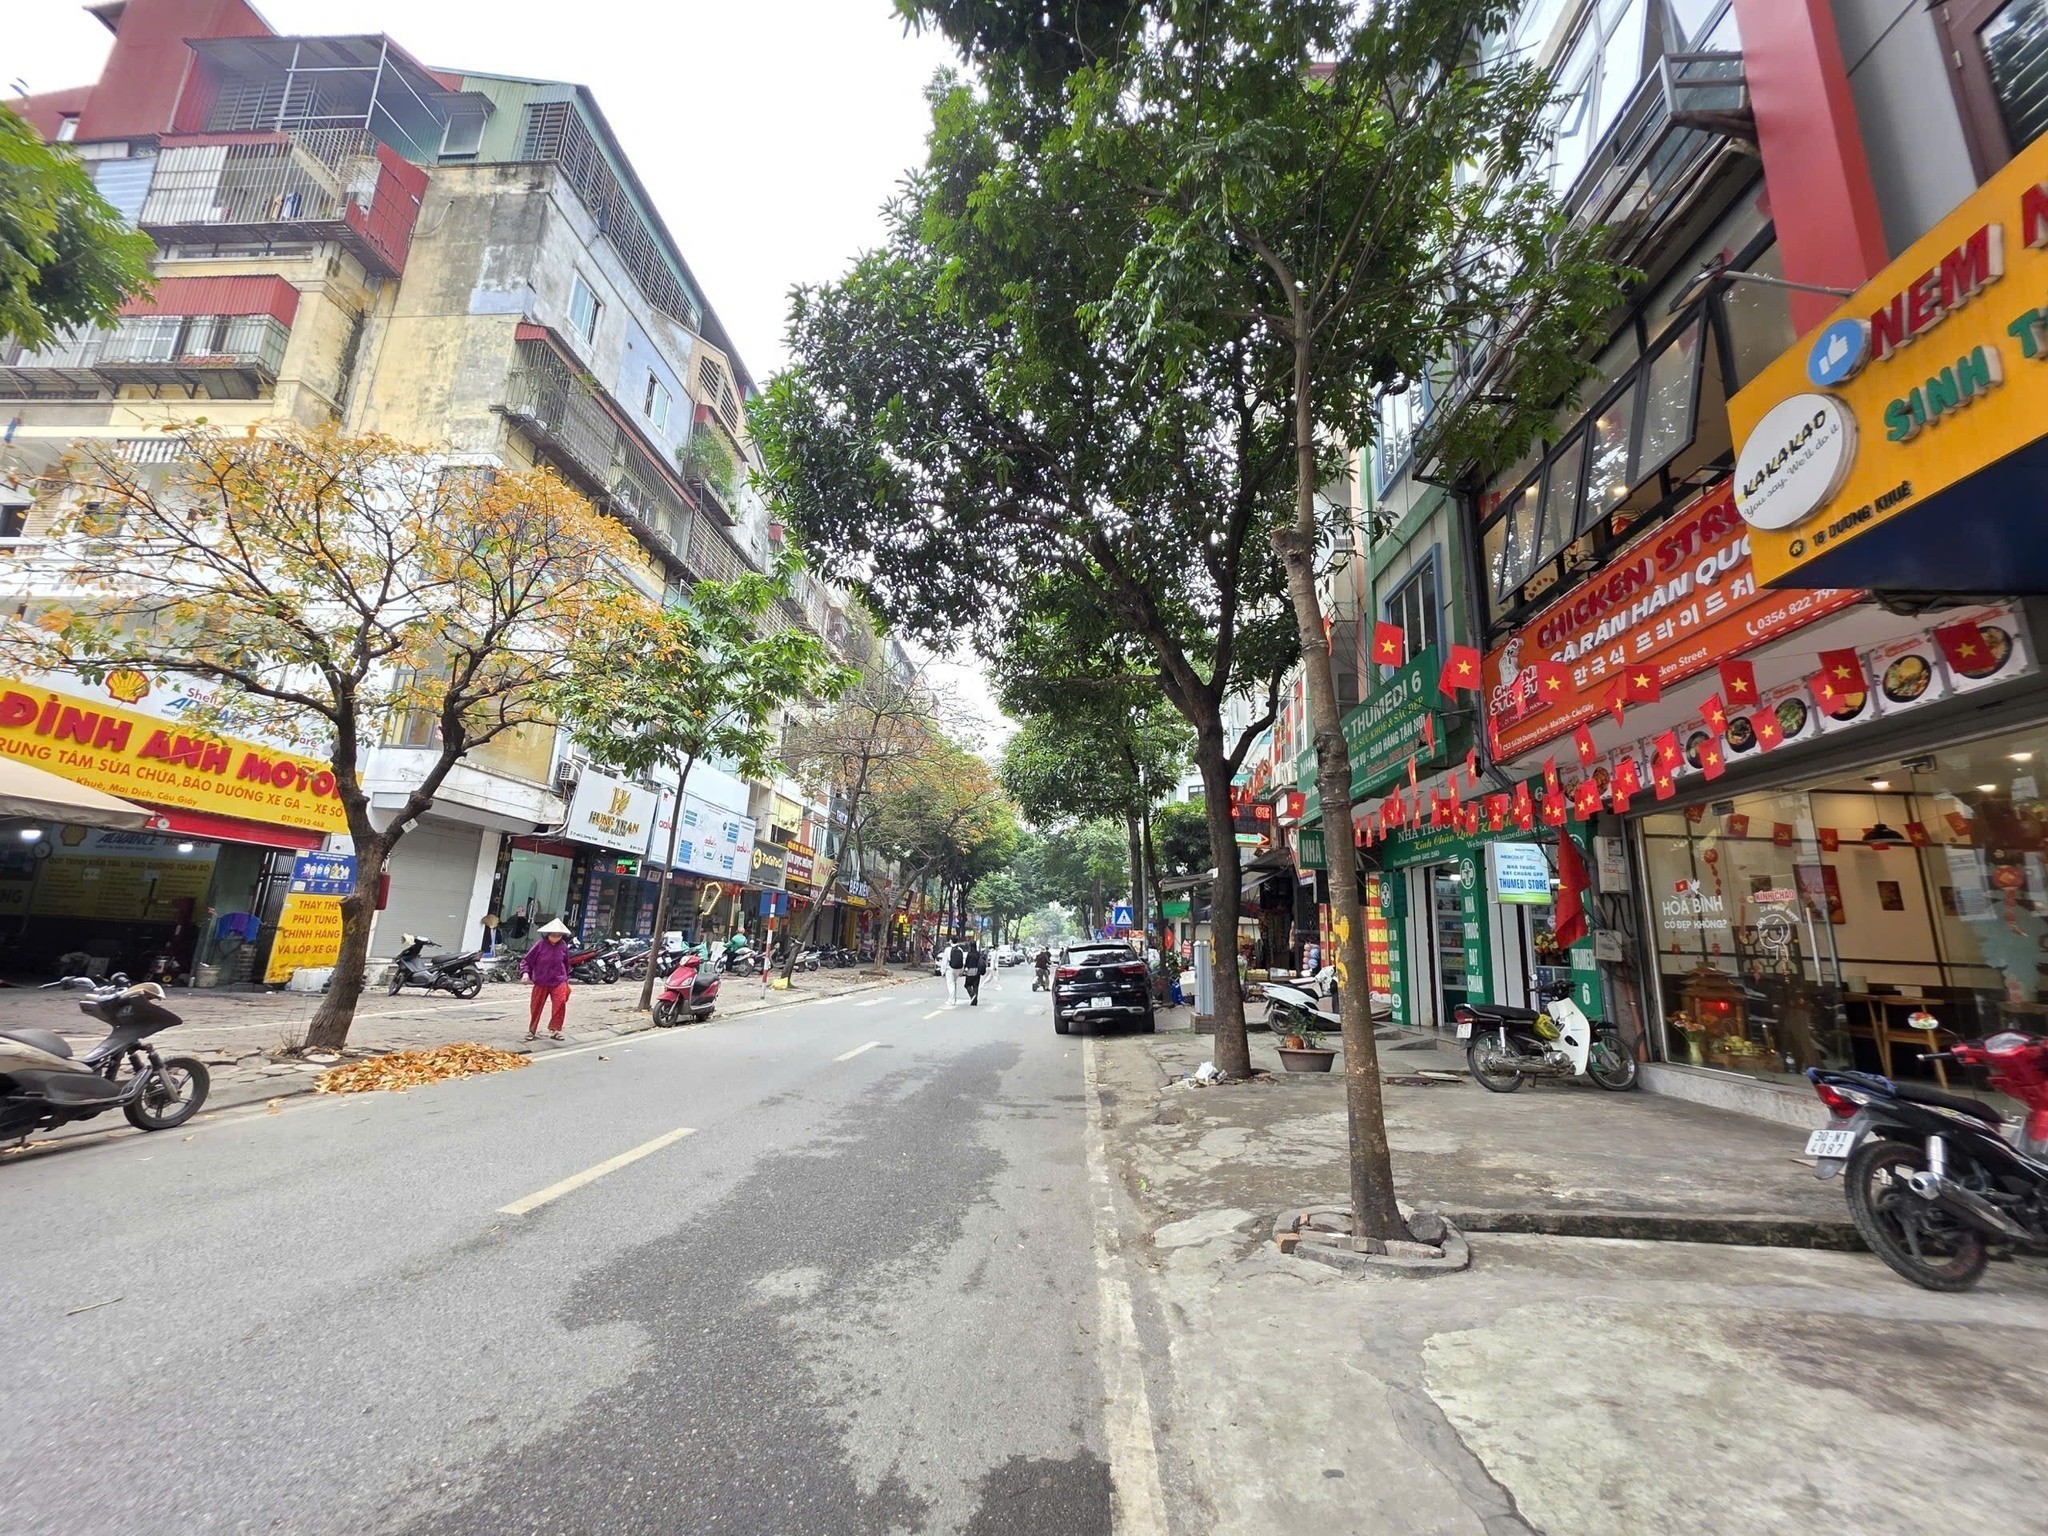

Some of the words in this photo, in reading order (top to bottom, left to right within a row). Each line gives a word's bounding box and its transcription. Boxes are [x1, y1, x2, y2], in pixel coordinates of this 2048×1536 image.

[1870, 223, 2000, 361] NEM
[1884, 345, 1992, 442] SINH
[2007, 306, 2048, 359] T
[1815, 435, 1829, 450] do
[1812, 530, 1826, 547] 18
[1874, 480, 1913, 513] KHUÊ
[1537, 556, 1655, 649] CHICKEN
[1580, 608, 1629, 656] RÁN
[1631, 572, 1690, 625] HÀN
[1757, 608, 1786, 630] 0356
[1788, 596, 1812, 615] 822
[1573, 644, 1626, 688] 한국식
[1678, 647, 1708, 668] Street
[187, 688, 218, 705] Shell
[1351, 679, 1408, 737] THUMEDI
[1411, 670, 1422, 693] 6
[0, 690, 134, 752] ĐÌNH
[136, 729, 233, 775] ANH
[59, 748, 94, 769] TÂM
[266, 793, 282, 806] XE
[284, 797, 300, 810] GA
[313, 803, 328, 816] XE
[109, 783, 129, 794] Mai
[1301, 834, 1323, 863] NHÀ
[1499, 878, 1527, 890] THUMEDI
[1528, 879, 1547, 890] STORE
[1755, 889, 1774, 901] KÍNH
[1774, 887, 1795, 900] CHÀO
[299, 900, 322, 910] THAY
[1662, 895, 1690, 916] HÒA
[1692, 892, 1723, 914] BÌNH
[293, 915, 311, 926] PHỤ
[1664, 917, 1675, 929] CÓ
[1676, 920, 1692, 932] ĐẸP
[1693, 917, 1728, 929] KHÔNG?
[313, 943, 325, 953] XE
[326, 944, 339, 953] GA
[1582, 983, 1591, 1005] 6
